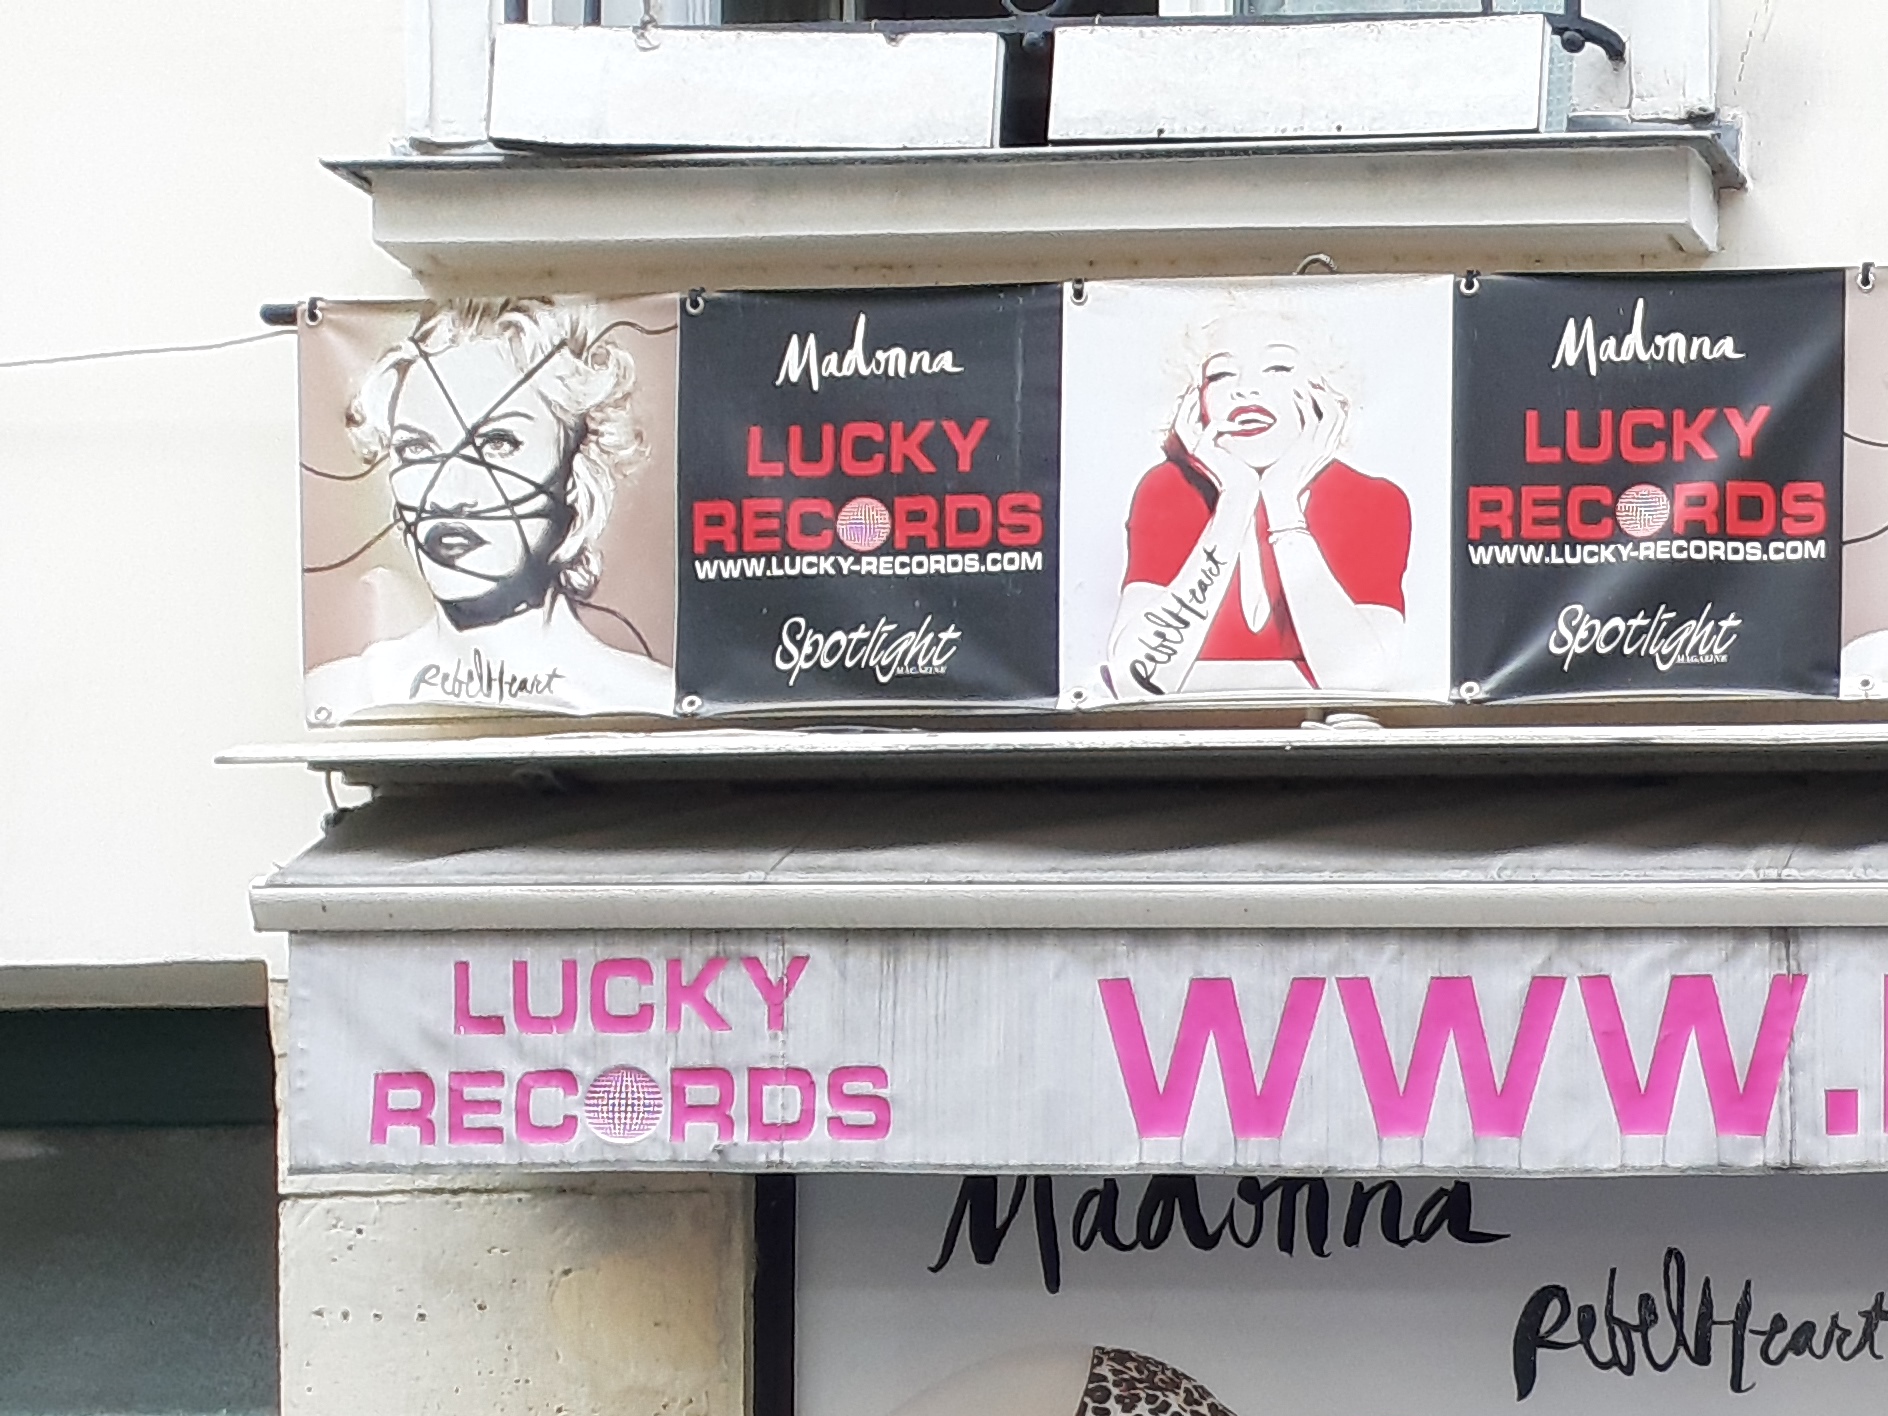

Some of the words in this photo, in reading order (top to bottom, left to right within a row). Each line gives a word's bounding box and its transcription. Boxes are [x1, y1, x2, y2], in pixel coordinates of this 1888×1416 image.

[776, 314, 964, 391] Madonna
[1552, 298, 1745, 376] Madonna
[748, 419, 988, 477] LUCKY
[1526, 407, 1770, 464] LUCKY
[694, 493, 1043, 554] RECORDS
[1468, 481, 1827, 540] RECORDS
[695, 546, 1042, 579] WWW.LUCKY-RECORDS.COM
[1469, 540, 1825, 564] WWW.LUCKY-RECORDS.COM
[776, 615, 962, 686] Spotlight
[1549, 603, 1742, 671] Spotlight
[456, 957, 808, 1034] LUCKY
[372, 1067, 891, 1144] RECORDS
